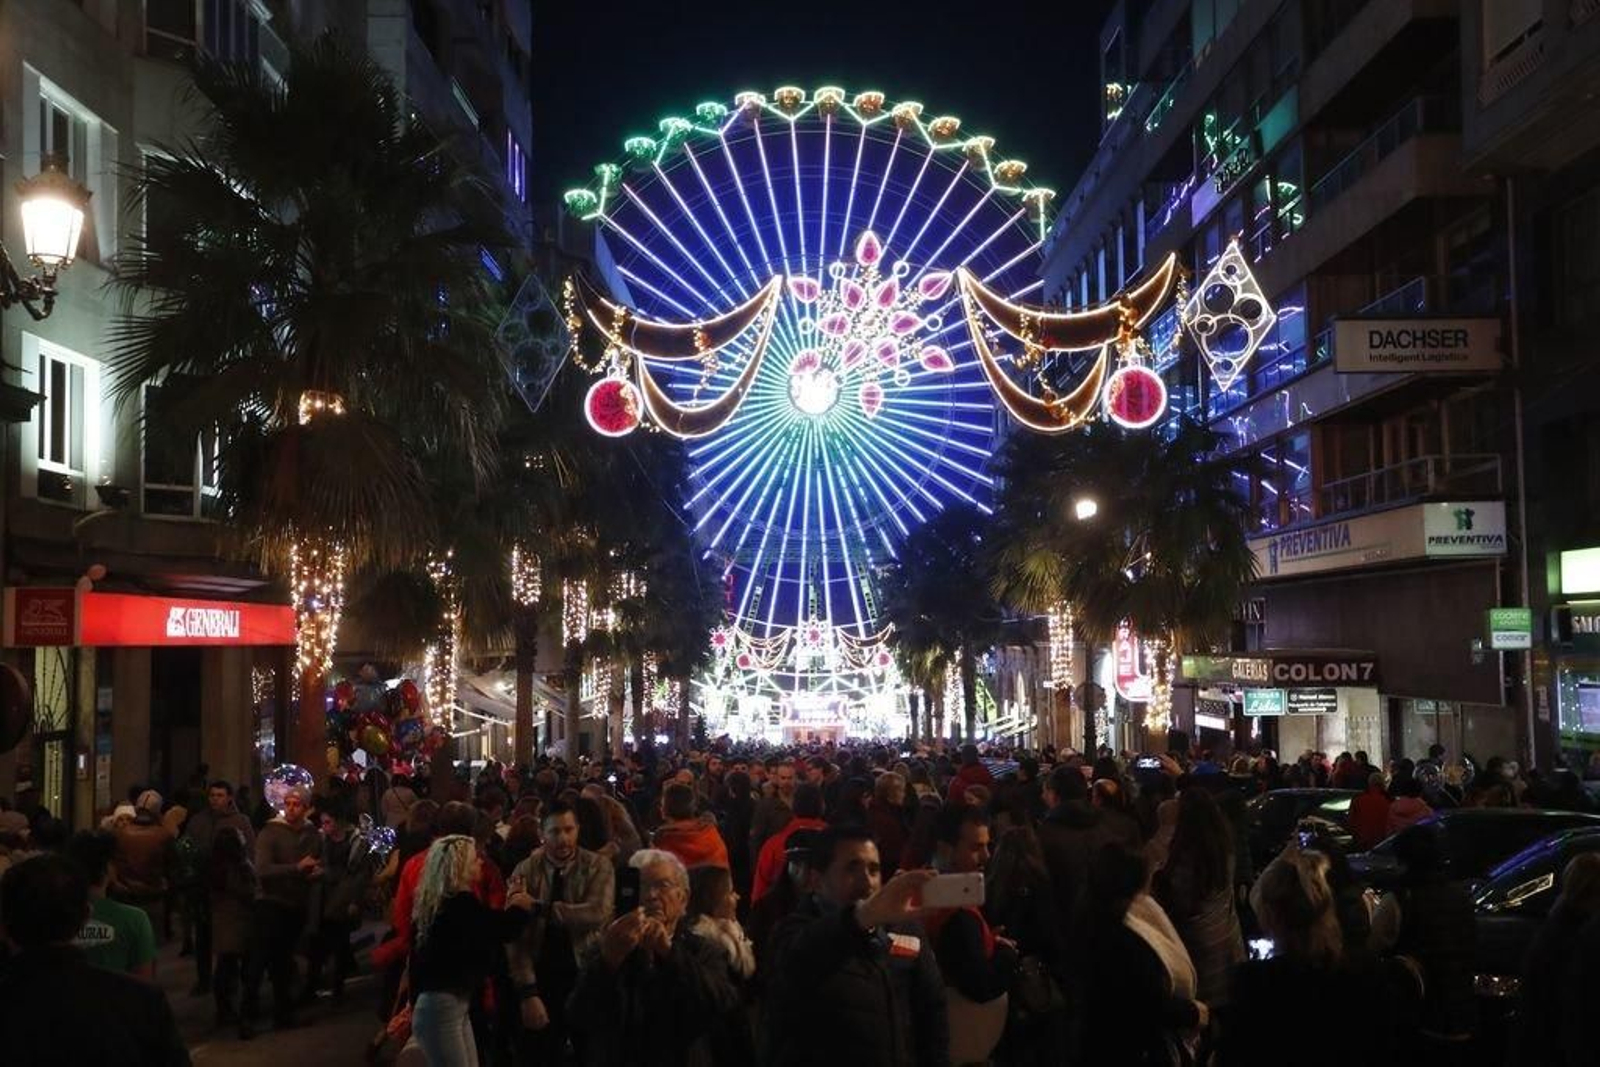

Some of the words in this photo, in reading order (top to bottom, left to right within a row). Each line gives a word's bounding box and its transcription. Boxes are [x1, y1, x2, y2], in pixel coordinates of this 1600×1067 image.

[1369, 329, 1468, 349] DACHSER
[1369, 353, 1420, 363] Intelligent
[1279, 523, 1352, 558] PREVENTIVA
[1428, 534, 1504, 545] PREVENTIVA
[185, 608, 239, 637] GENERALI
